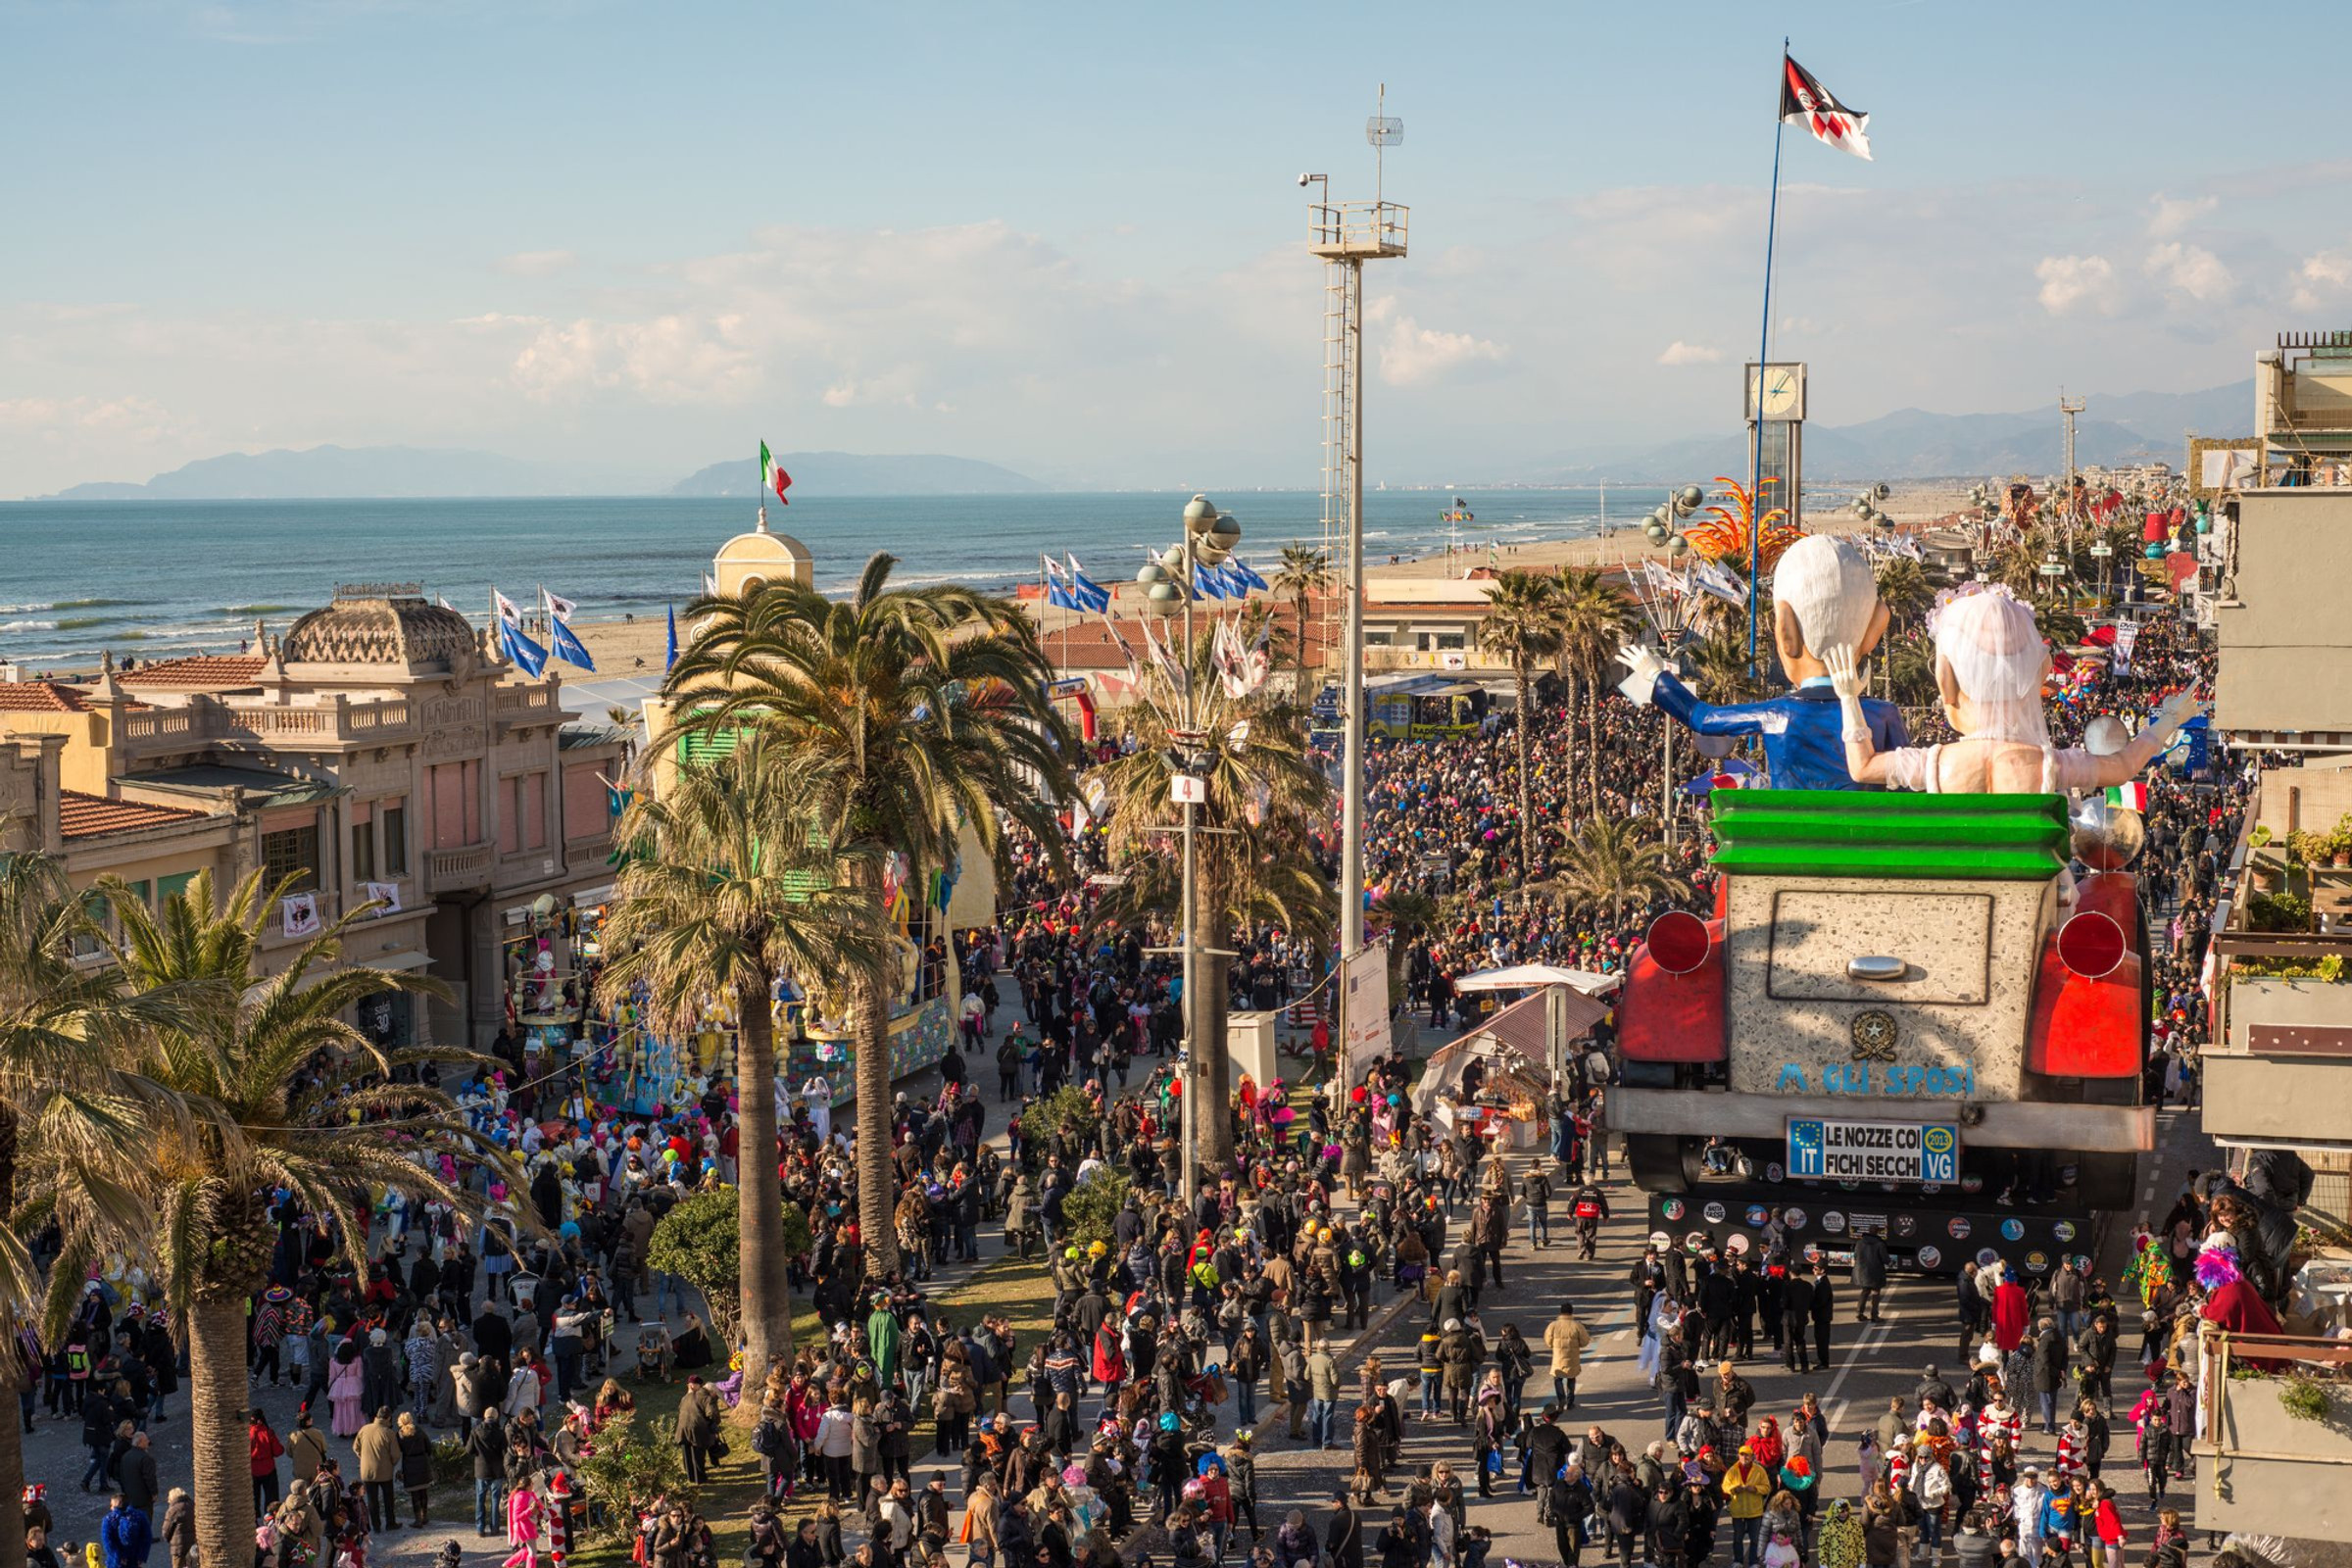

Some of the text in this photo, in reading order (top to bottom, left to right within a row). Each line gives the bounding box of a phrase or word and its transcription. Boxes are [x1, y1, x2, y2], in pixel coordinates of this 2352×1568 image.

[1182, 779, 1192, 800] 4
[1823, 1059, 1871, 1095] GLI
[1885, 1058, 1976, 1096] SPOSI
[1825, 1127, 1921, 1150] LE NOZZE COI
[1929, 1134, 1950, 1147] 2013
[1801, 1148, 1818, 1173] IT
[1825, 1153, 1921, 1177] FICHI SECCHI
[1927, 1153, 1952, 1180] VG
